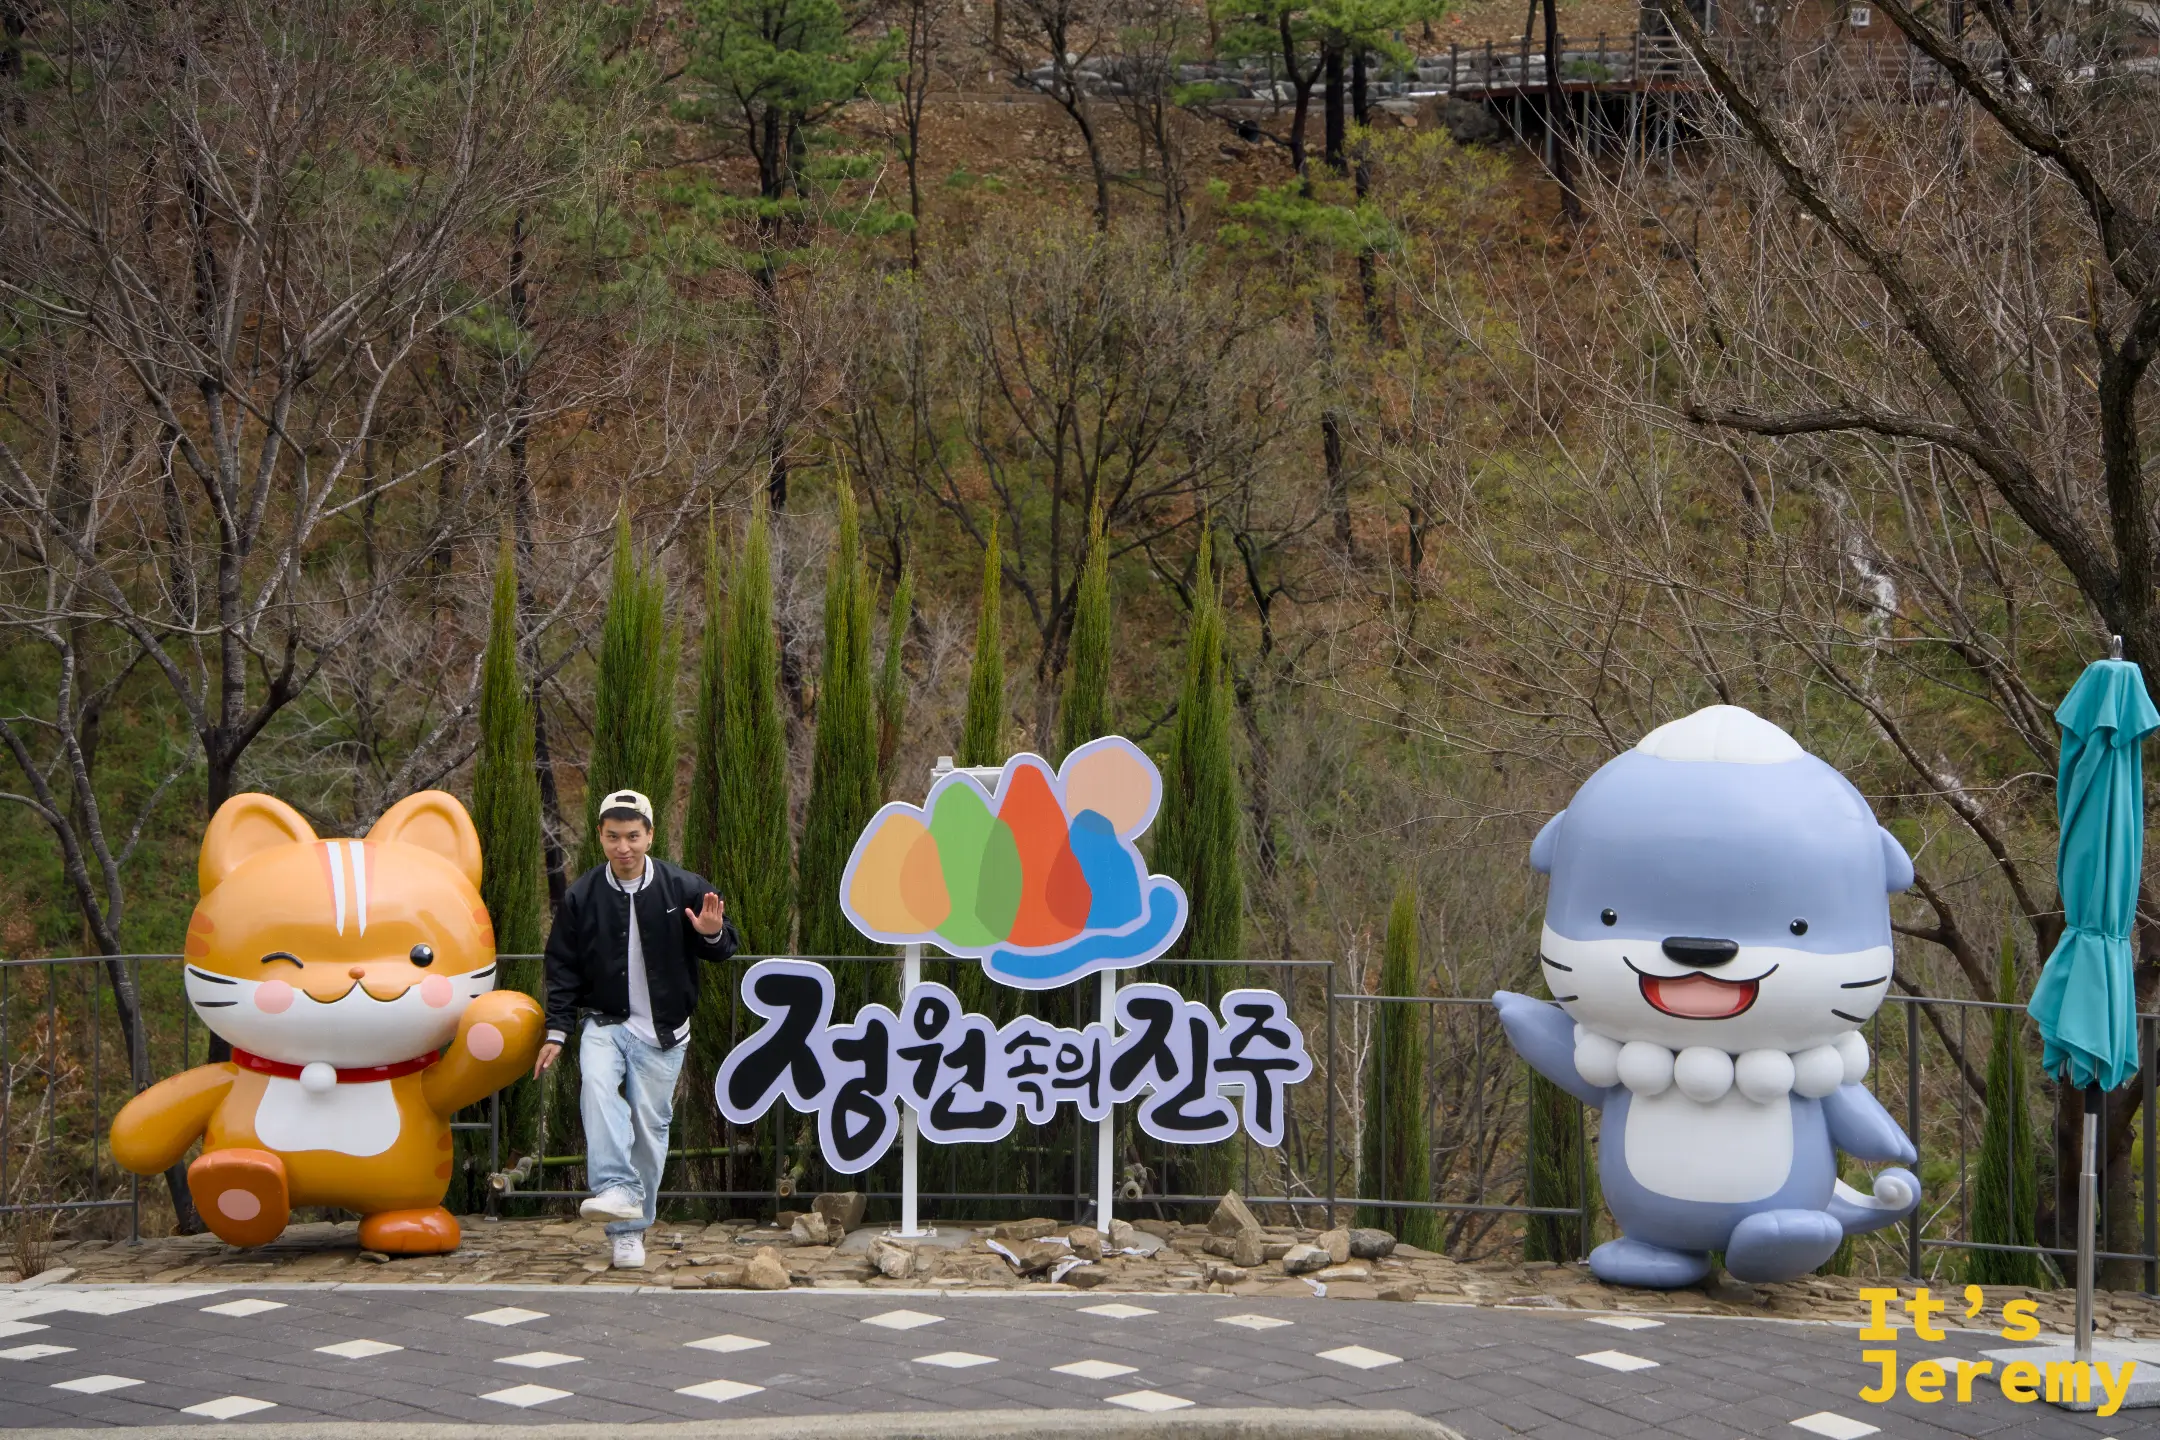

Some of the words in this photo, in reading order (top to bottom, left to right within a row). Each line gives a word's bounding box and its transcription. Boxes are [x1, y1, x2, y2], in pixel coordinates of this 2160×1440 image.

[728, 973, 1006, 1161] 정원
[1004, 1030, 1100, 1112] 속의
[1109, 998, 1300, 1133] 진주
